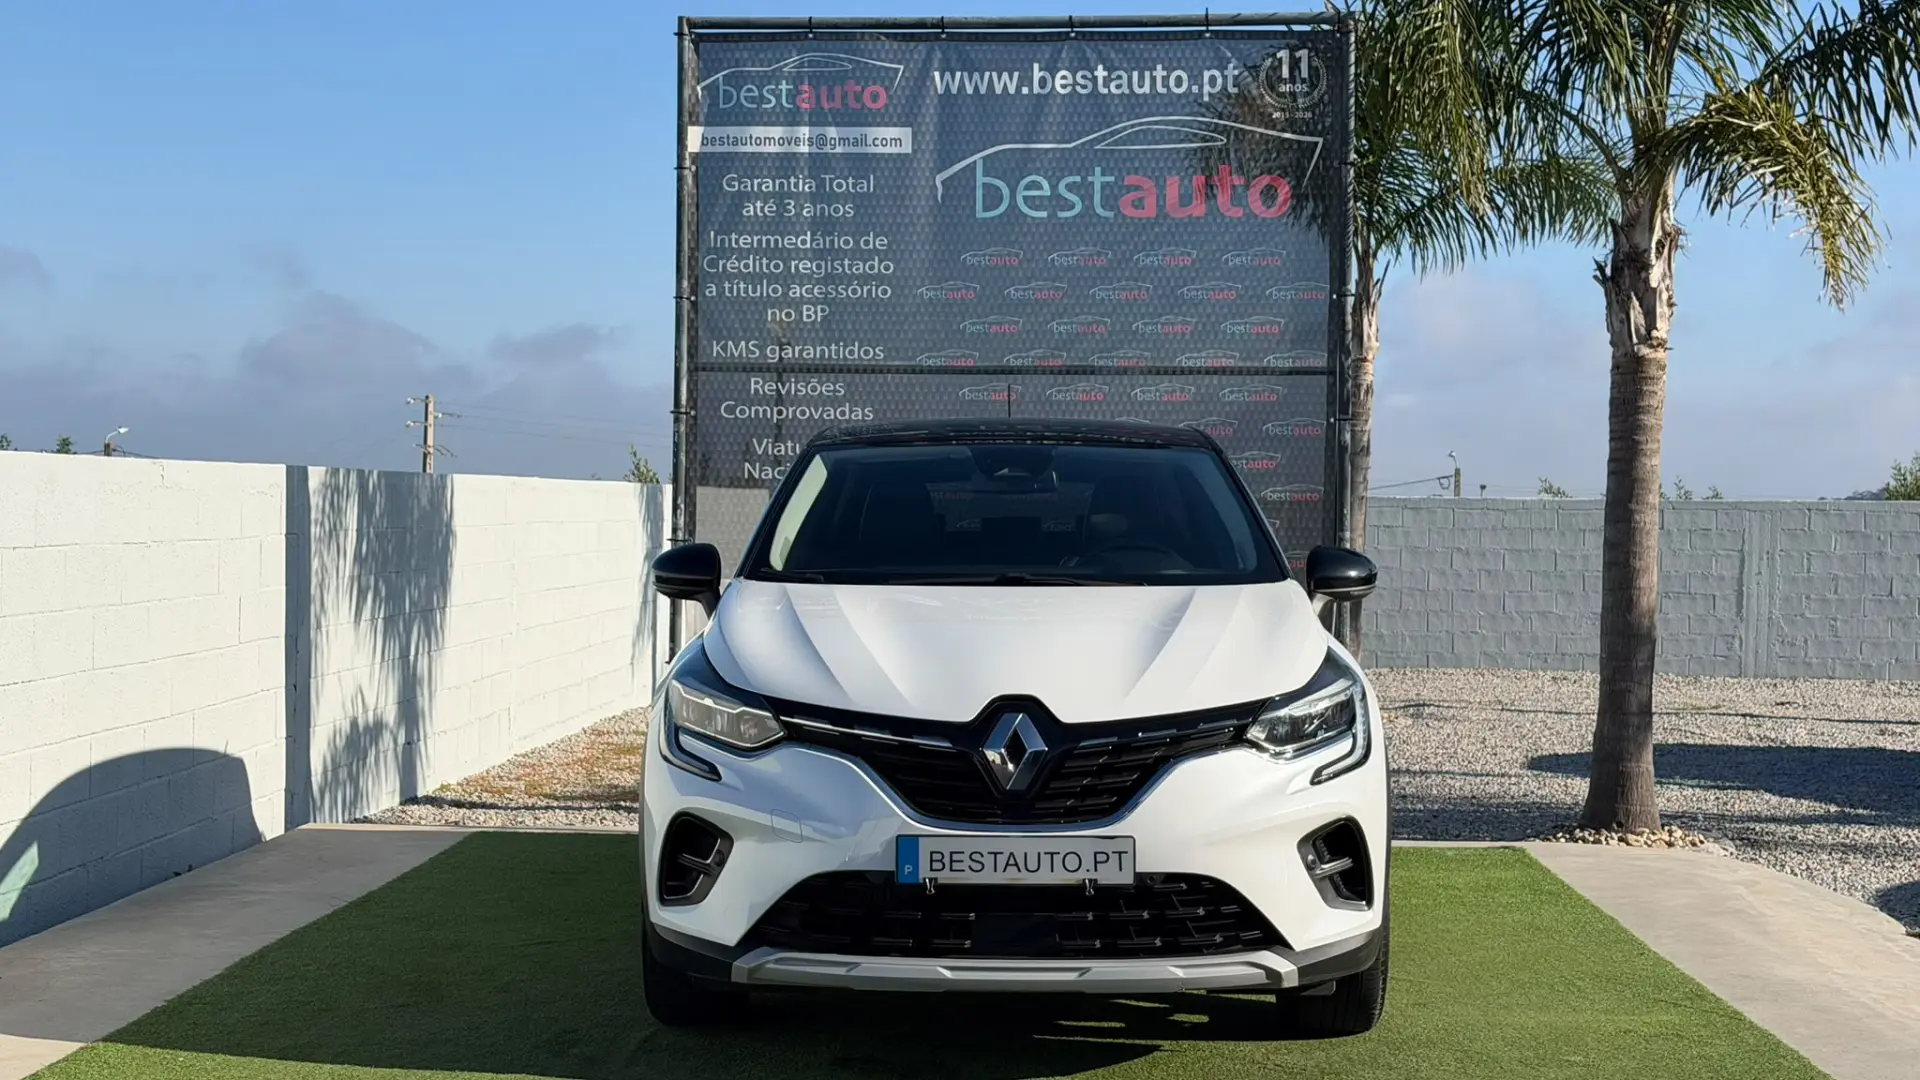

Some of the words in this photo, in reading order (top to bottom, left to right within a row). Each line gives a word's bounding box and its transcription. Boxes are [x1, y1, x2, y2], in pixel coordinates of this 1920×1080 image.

[1276, 48, 1309, 78] 11
[933, 62, 1239, 100] www.bestauto.pt
[718, 74, 887, 110] bestauto
[1278, 83, 1309, 92] anos
[701, 133, 903, 150] bestautomoveis@gmail.com
[722, 174, 816, 192] Garantia
[821, 174, 874, 193] Total
[975, 158, 1292, 219] bestauto
[742, 199, 777, 217] até
[783, 200, 796, 216] 3
[803, 203, 854, 217] anos
[710, 231, 853, 249] Intermedário
[860, 231, 888, 250] de
[703, 254, 784, 274] Crédito
[791, 256, 894, 277] registado
[966, 255, 1019, 266] bestauto
[1054, 255, 1107, 266] bestauto
[1139, 255, 1193, 266] bestauto
[1228, 255, 1281, 266] bestauto
[705, 284, 717, 297] a
[724, 279, 782, 297] título
[788, 280, 892, 299] acessório
[923, 288, 976, 299] bestauto
[1010, 288, 1063, 299] bestauto
[1095, 288, 1148, 299] bestauto
[1183, 288, 1237, 299] bestauto
[1272, 288, 1325, 299] bestauto
[767, 307, 795, 322] no
[802, 305, 829, 322] BP
[966, 322, 1019, 333] bestauto
[1053, 322, 1106, 333] bestauto
[1138, 322, 1192, 333] bestauto
[1226, 322, 1280, 333] bestauto
[712, 340, 760, 358] KMS
[766, 340, 885, 362] garantidos
[922, 356, 974, 367] bestauto
[1009, 356, 1062, 367] bestauto
[1094, 356, 1146, 367] bestauto
[1181, 356, 1235, 367] bestauto
[1270, 356, 1323, 367] bestauto
[750, 378, 846, 396] Revisões
[1052, 389, 1105, 400] bestauto
[1137, 389, 1189, 400] bestauto
[1225, 389, 1278, 400] bestauto
[720, 401, 874, 423] Comprovadas
[1268, 425, 1322, 436] bestauto
[1231, 459, 1277, 469] estauto
[744, 461, 790, 479] Nac
[1266, 490, 1320, 501] bestauto
[904, 865, 913, 875] P
[929, 850, 1129, 873] BESTAUTO.PT
